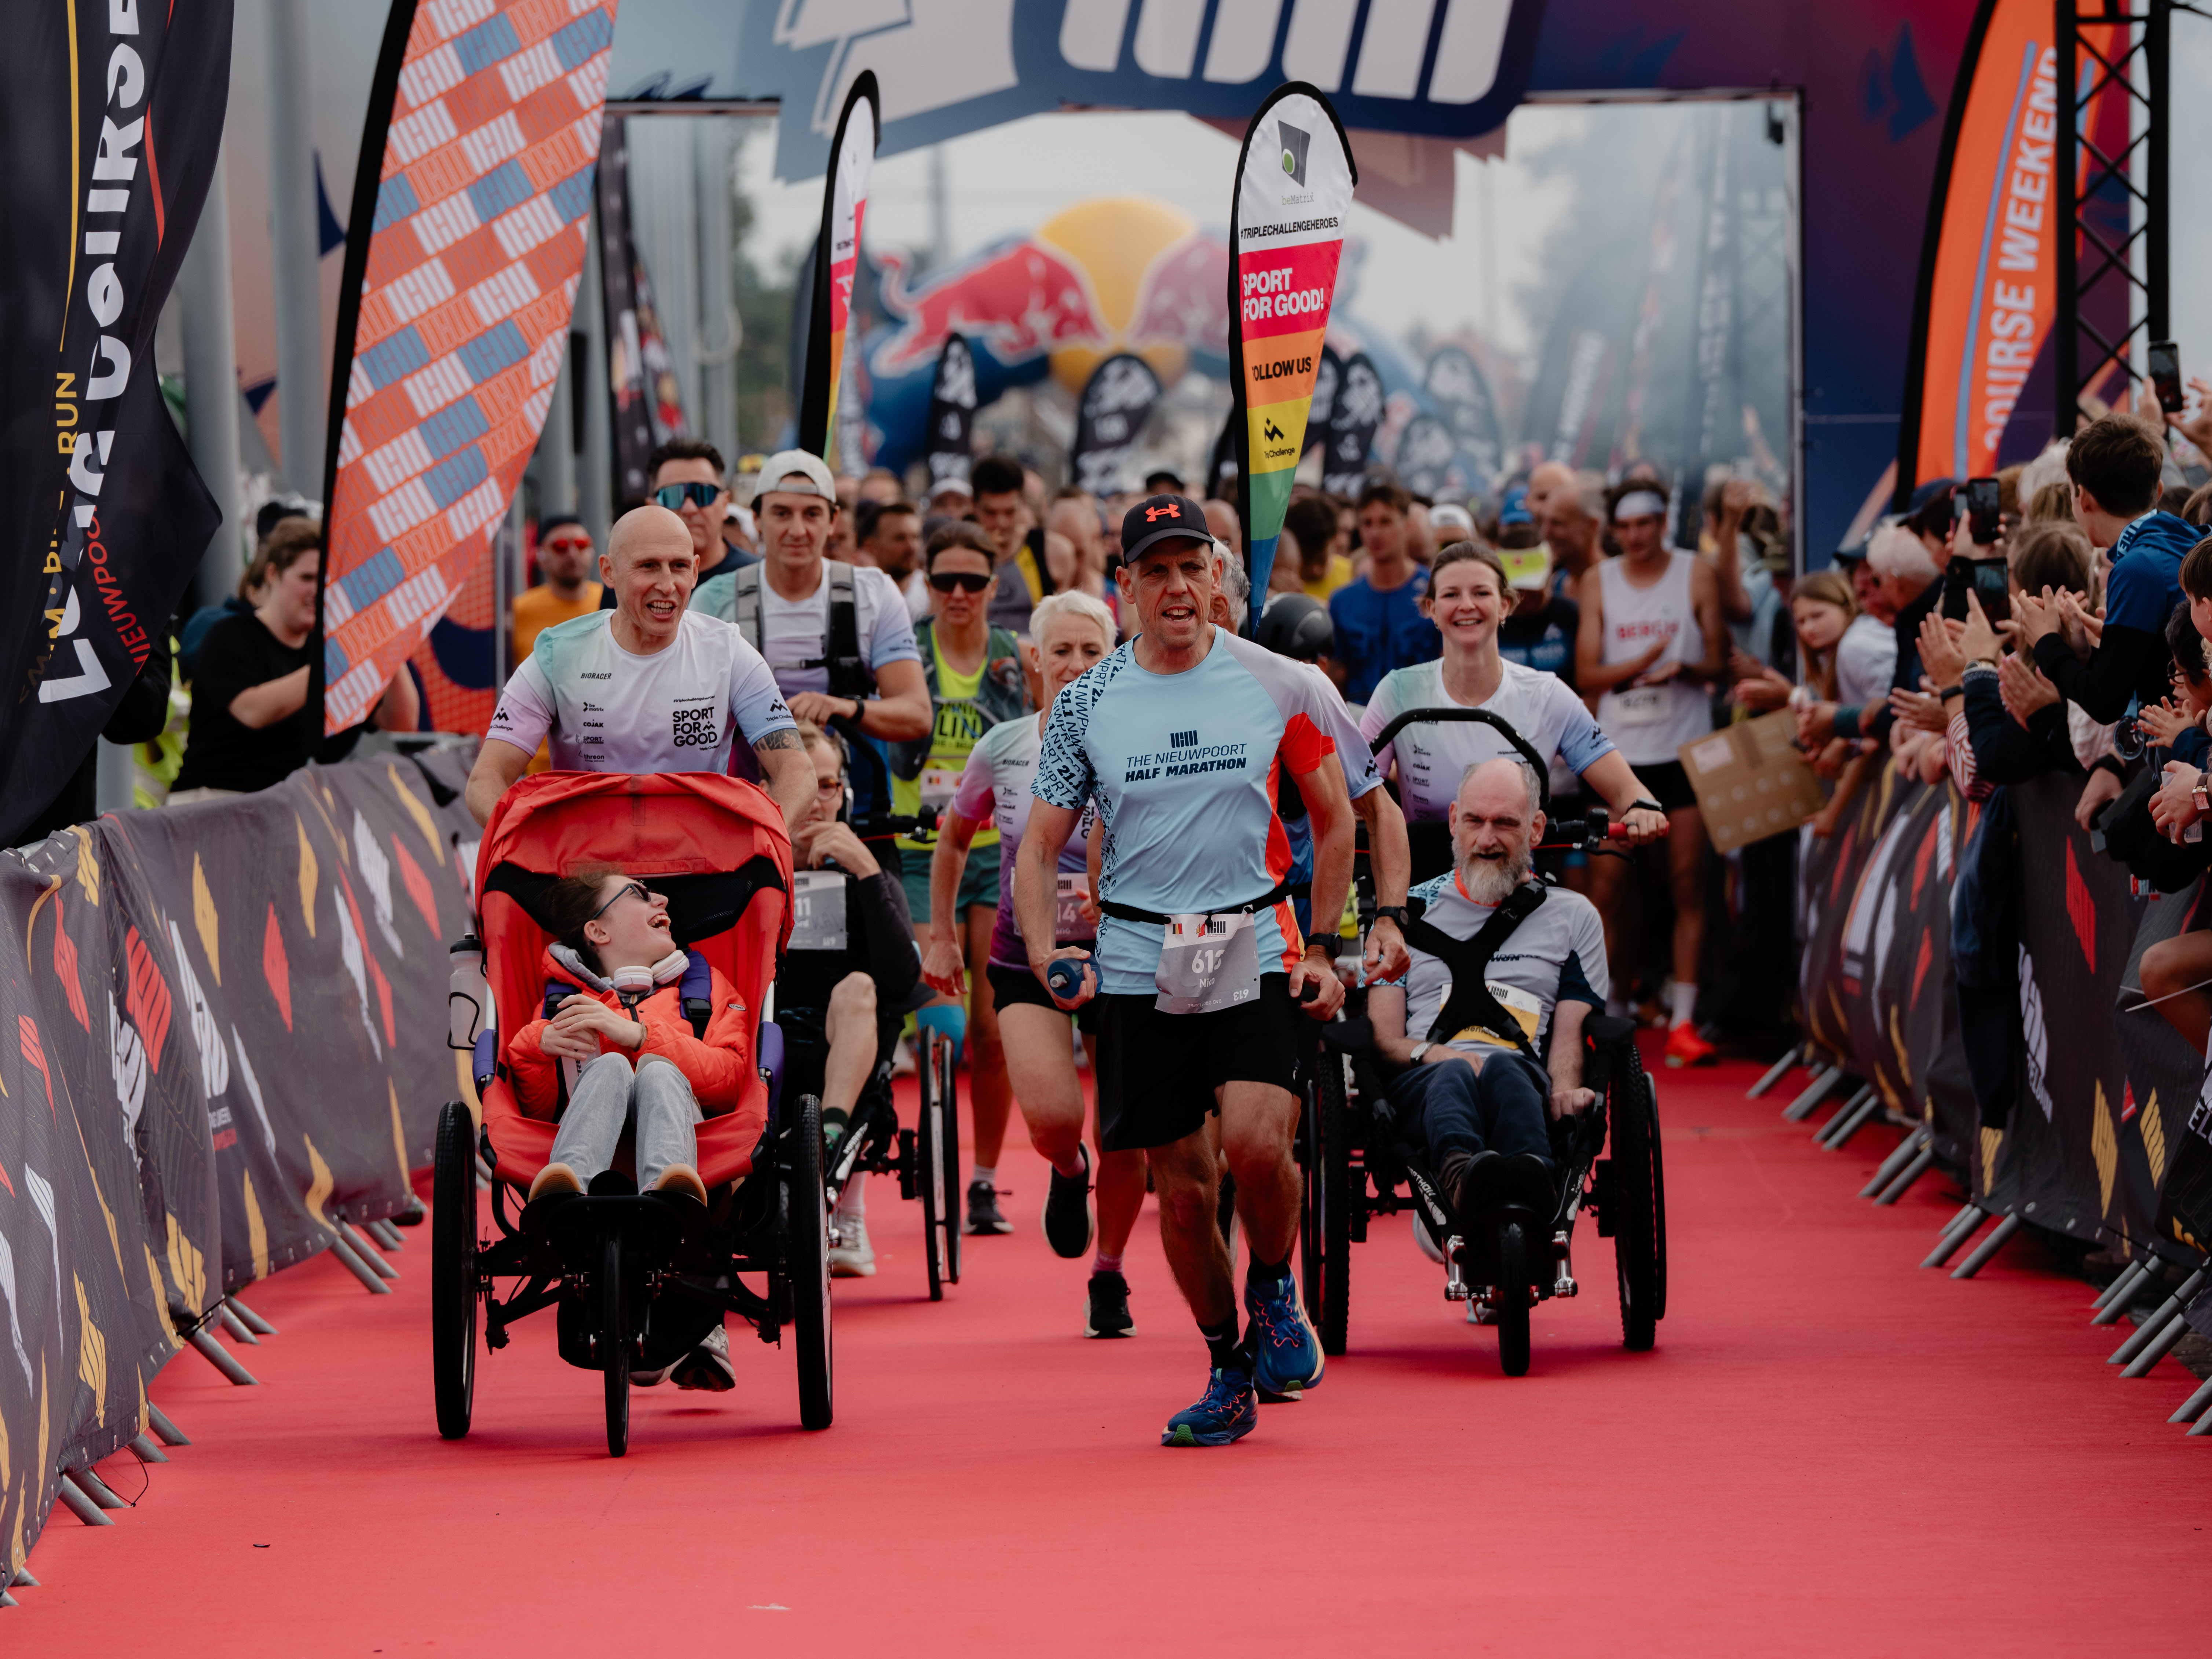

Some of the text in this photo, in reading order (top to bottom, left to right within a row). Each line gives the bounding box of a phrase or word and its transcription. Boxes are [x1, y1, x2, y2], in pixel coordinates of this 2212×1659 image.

[1243, 268, 1293, 297] SPORT
[1243, 288, 1324, 322] FOR GOOD!
[1297, 357, 1312, 374] US
[1269, 447, 1295, 458] Challenge
[1060, 690, 1074, 717] 21.1
[673, 706, 714, 723] SPORT
[673, 721, 702, 735] FOR
[673, 731, 717, 747] GOOD
[1127, 743, 1247, 768] THE NIEUWPOORT
[1057, 765, 1084, 790] 21.1
[1125, 757, 1247, 783] HALF MARATHON
[1199, 978, 1215, 988] Nico
[1233, 989, 1249, 1001] 613
